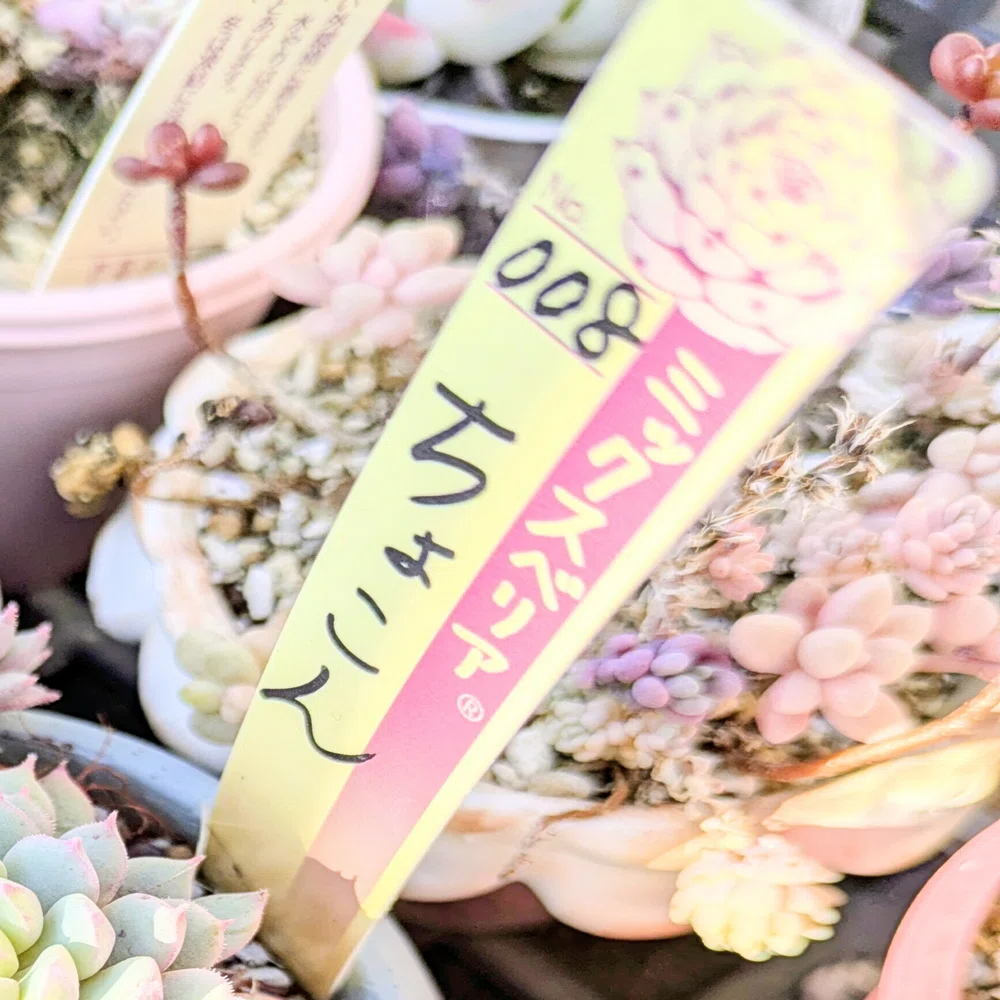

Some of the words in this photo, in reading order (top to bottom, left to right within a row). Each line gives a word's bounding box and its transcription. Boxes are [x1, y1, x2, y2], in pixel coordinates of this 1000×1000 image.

[495, 239, 645, 359] 008
[260, 382, 516, 764] ちょこん
[451, 346, 725, 678] ミックスベリア
